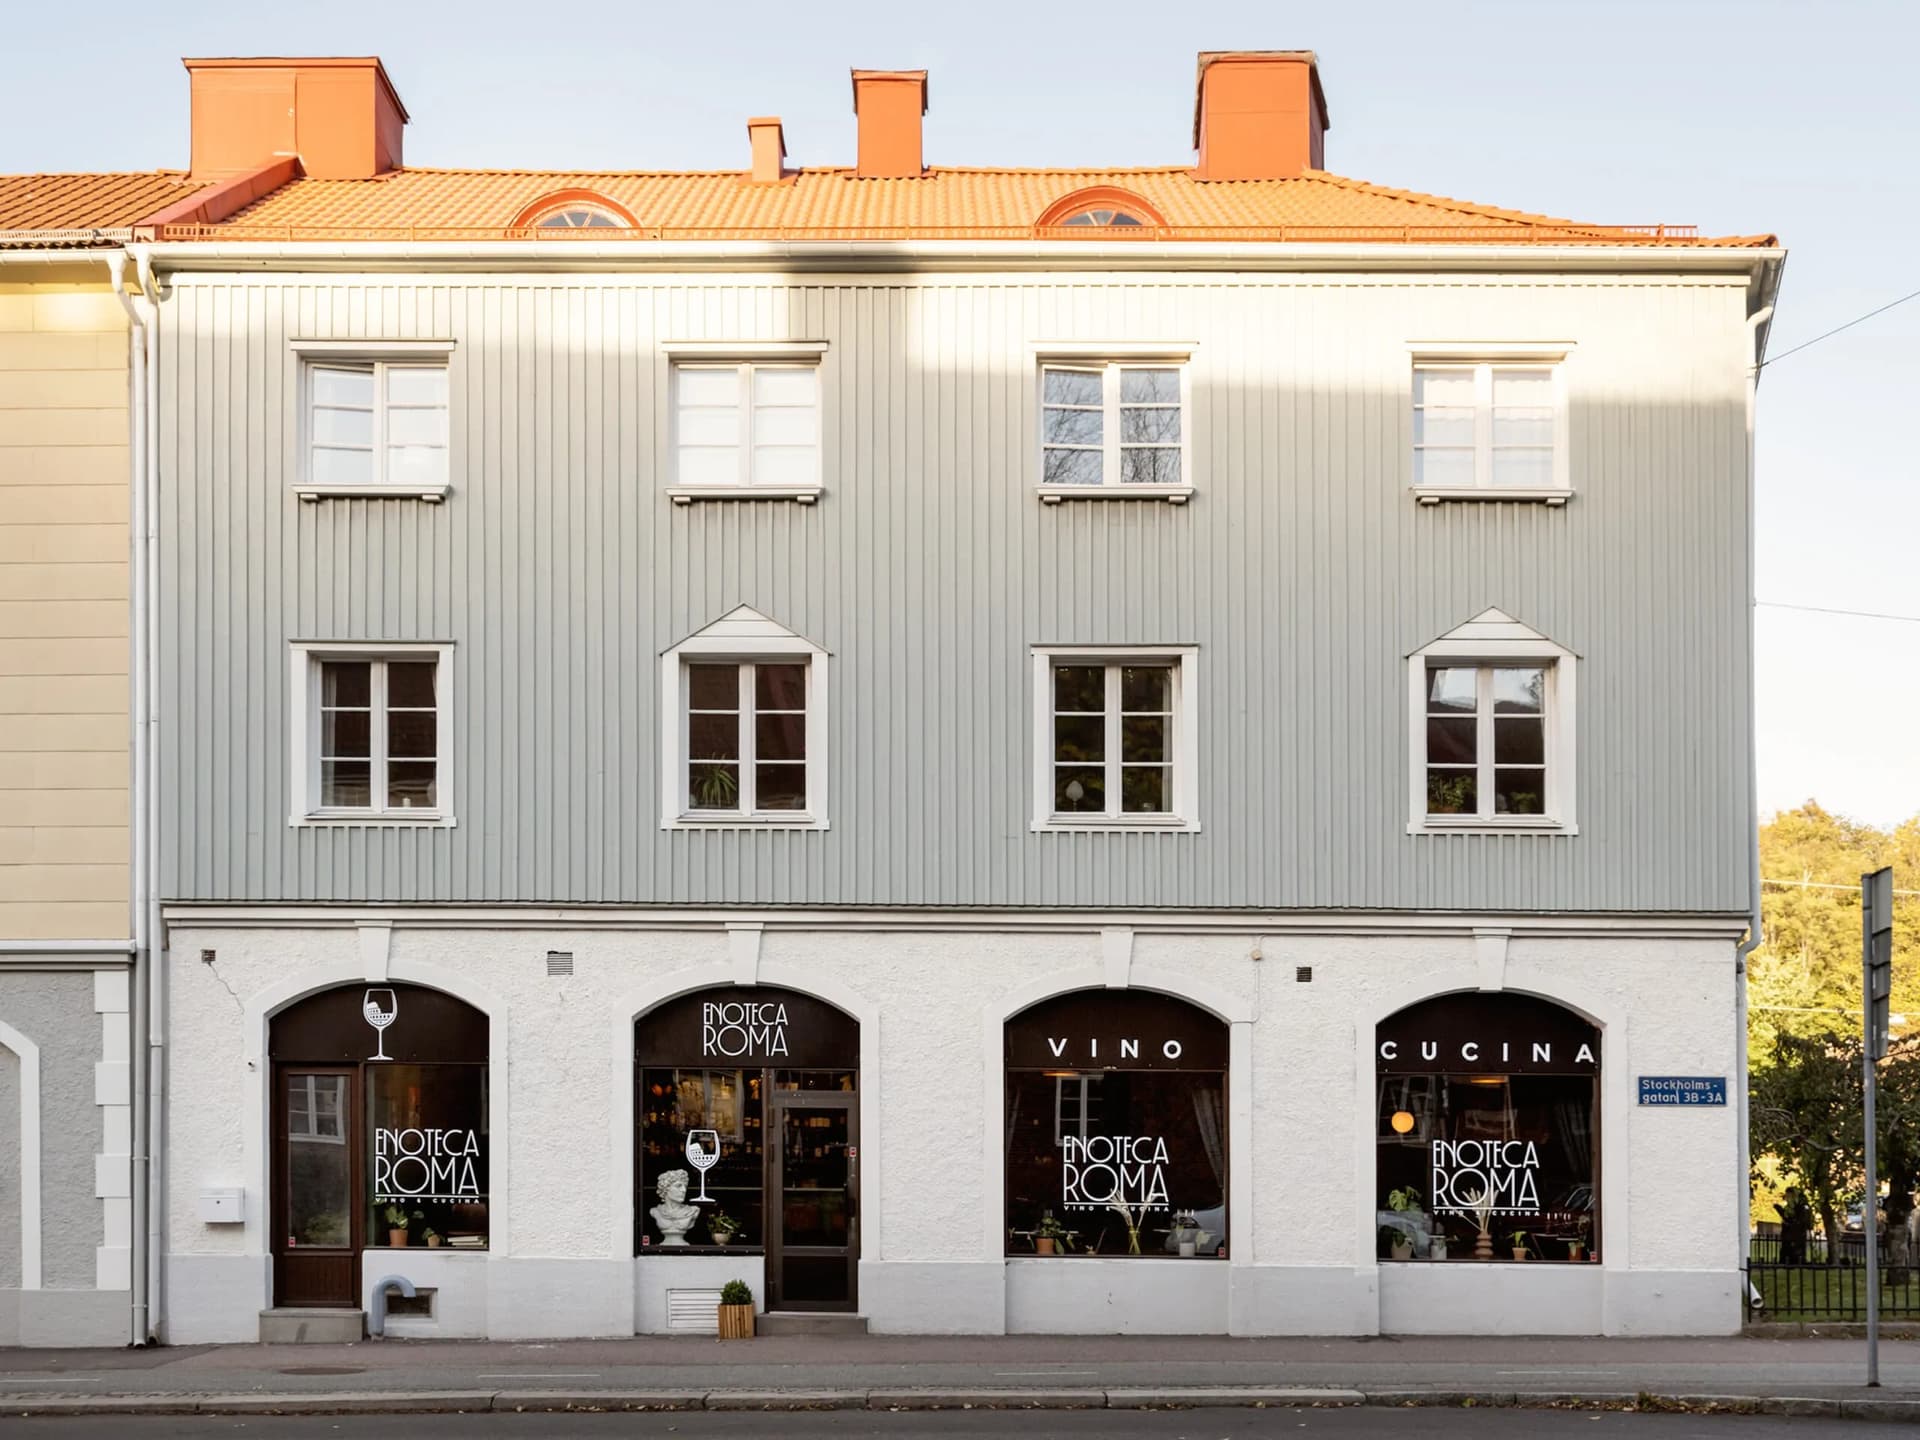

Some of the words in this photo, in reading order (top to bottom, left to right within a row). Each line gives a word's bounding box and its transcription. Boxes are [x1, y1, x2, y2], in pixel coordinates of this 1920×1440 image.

[703, 1002, 789, 1026] ENOTECA
[703, 1025, 789, 1056] ROMA
[1047, 1037, 1182, 1058] VINO
[1380, 1041, 1596, 1064] CUCINA
[1642, 1093, 1677, 1104] gatan
[375, 1128, 480, 1156] ENOTECA
[1063, 1136, 1170, 1164] ENOTECA
[1432, 1140, 1540, 1167] ENOTECA
[375, 1156, 480, 1194] ROMA
[1063, 1163, 1170, 1203] ROMA
[1432, 1167, 1540, 1206] ROMA
